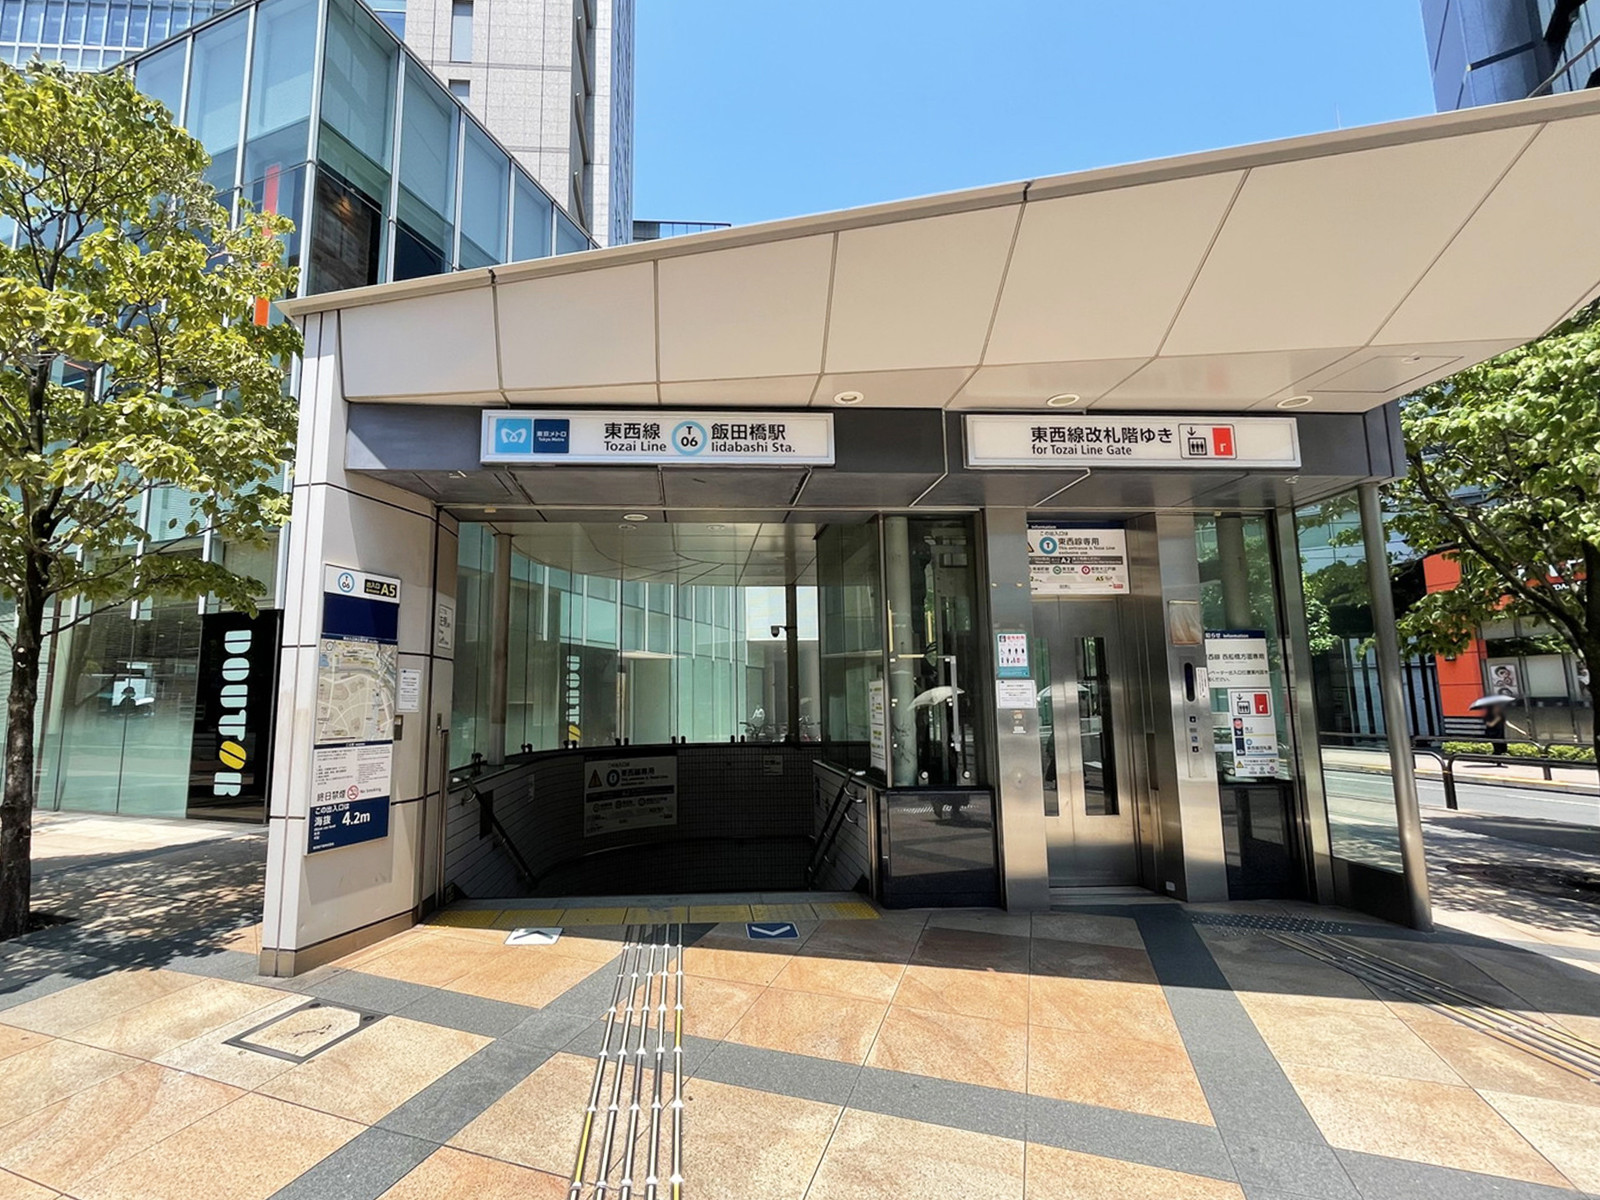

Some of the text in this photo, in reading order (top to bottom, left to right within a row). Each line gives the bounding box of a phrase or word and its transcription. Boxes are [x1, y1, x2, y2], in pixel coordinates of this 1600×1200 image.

[604, 422, 661, 440] 東西線
[686, 426, 693, 435] T
[711, 422, 787, 442] 飯田橋駅
[1030, 426, 1173, 444] 東西線改札階ゆき
[604, 441, 667, 452] Tozai Line
[680, 436, 698, 448] 06
[711, 441, 796, 453] Iidabashi Sta.
[1032, 444, 1132, 456] for Tozai Line Gate
[380, 584, 396, 597] A5
[566, 655, 581, 748] DOUTO
[213, 629, 253, 797] DOUTOR
[314, 803, 350, 815] この出入口は
[313, 815, 332, 827] 海抜
[341, 811, 371, 826] 4.2m
